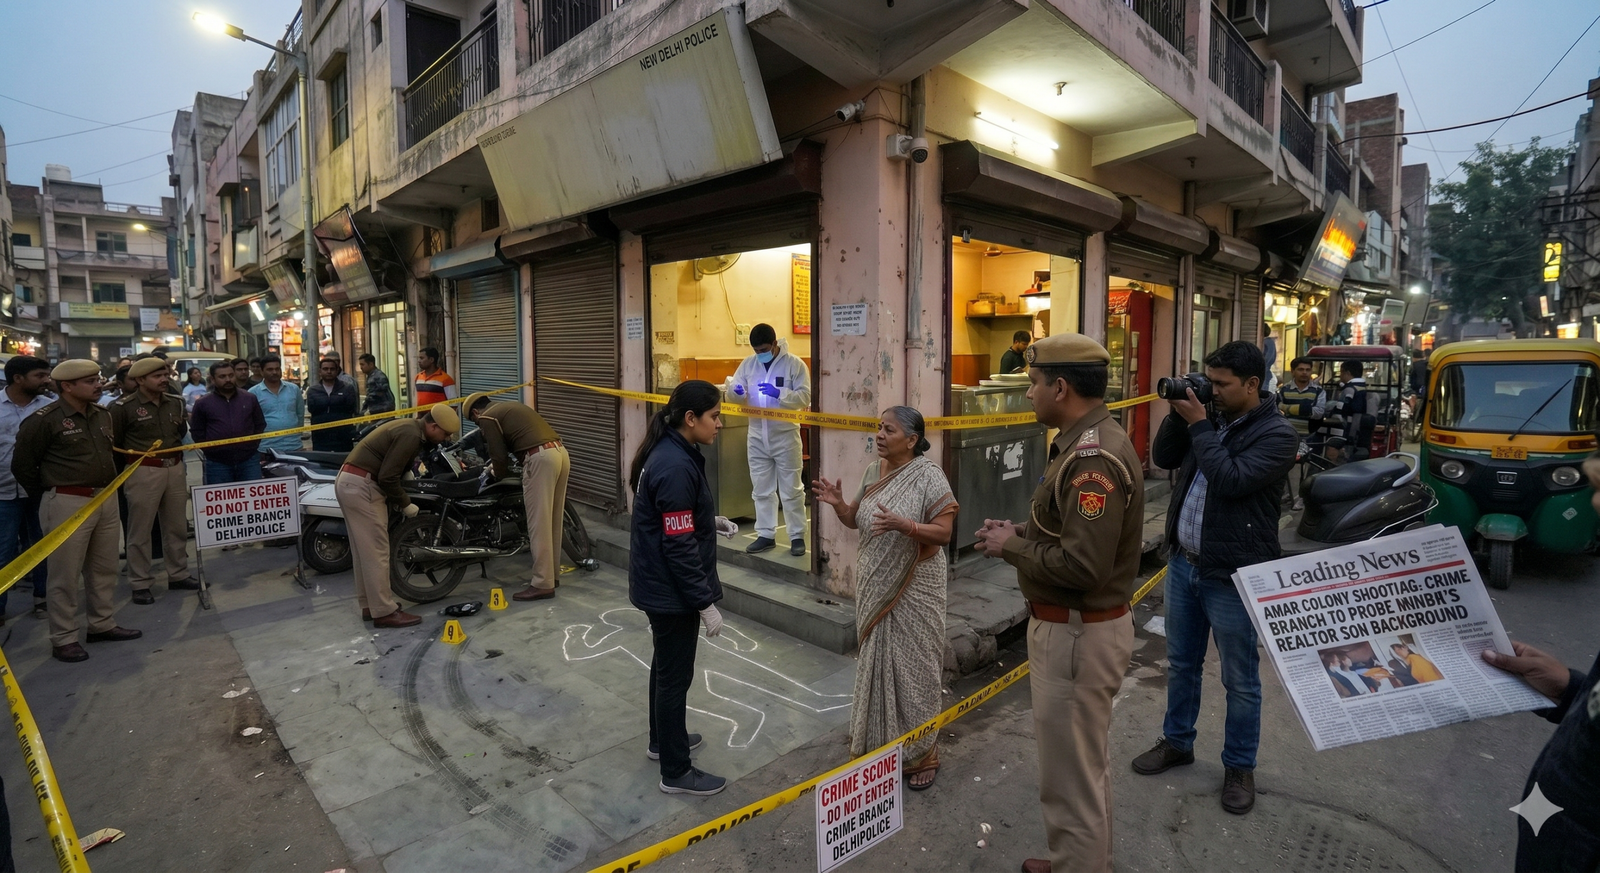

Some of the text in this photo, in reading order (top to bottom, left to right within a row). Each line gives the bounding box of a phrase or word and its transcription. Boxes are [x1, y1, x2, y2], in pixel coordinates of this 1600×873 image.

[639, 23, 719, 71] NEW DELHI POLICE
[205, 483, 287, 502] CRIME SCENE
[226, 501, 249, 514] NOT
[253, 496, 290, 511] ENTER
[207, 509, 291, 530] CRIME BRANCH
[216, 522, 285, 541] DELHIPOLICE
[665, 514, 694, 531] POLICE
[1274, 561, 1360, 590] Leading
[1359, 549, 1420, 574] News
[1263, 602, 1300, 620] AMAR
[1301, 592, 1350, 613] COLONY
[1424, 569, 1471, 590] CRIME
[1268, 613, 1327, 637] BRANCH
[1328, 609, 1347, 625] TO
[1347, 600, 1393, 622] PROBE
[1275, 631, 1341, 653] REALTOR
[1342, 623, 1370, 640] SON
[1370, 605, 1469, 635] BACKGROUND
[821, 772, 859, 807] CRIME
[862, 753, 897, 786] SCONE
[826, 795, 895, 845] CRIME BRANCH
[827, 805, 841, 826] DO
[844, 793, 863, 817] NOT
[833, 815, 891, 861] DELHIPOLICE
